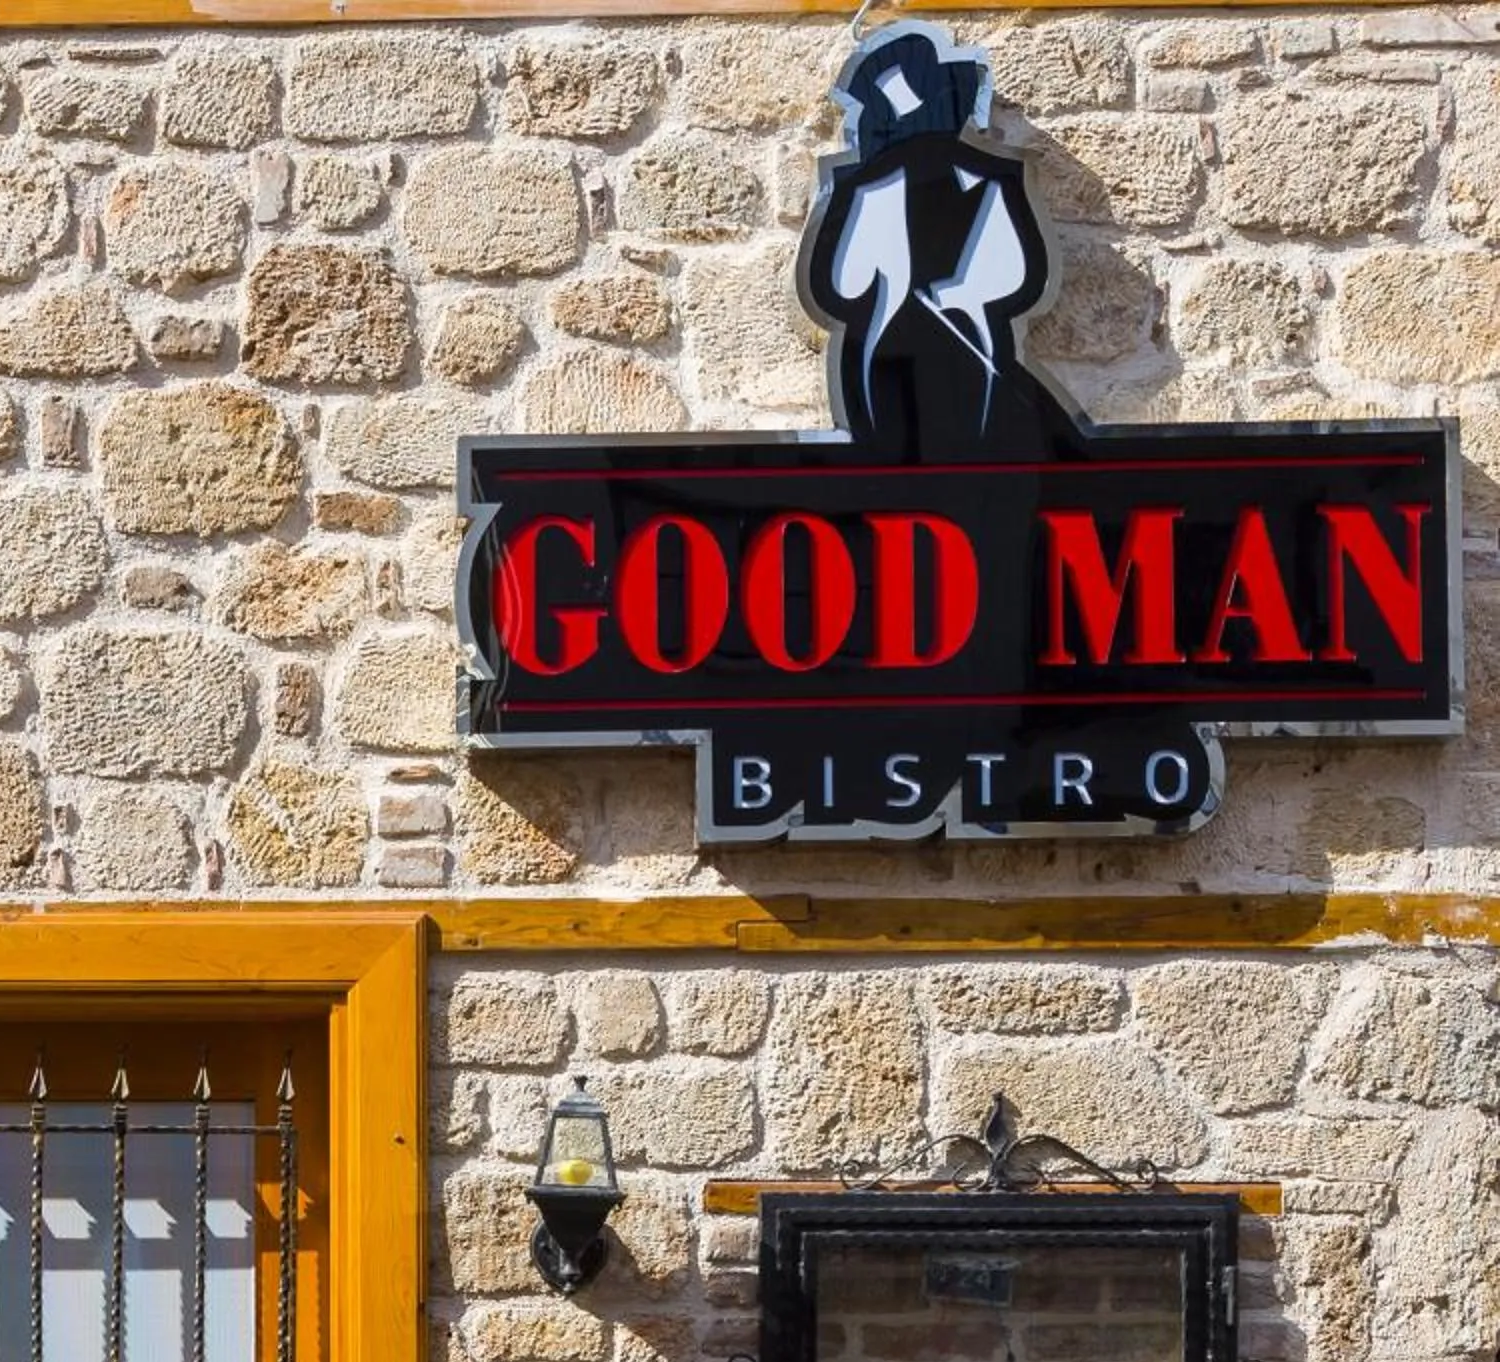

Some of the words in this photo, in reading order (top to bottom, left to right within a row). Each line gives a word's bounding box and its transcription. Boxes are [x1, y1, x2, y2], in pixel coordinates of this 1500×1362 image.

[493, 512, 980, 676] GOOD
[1037, 505, 1430, 666] MAN
[732, 750, 1190, 809] BISTRO
